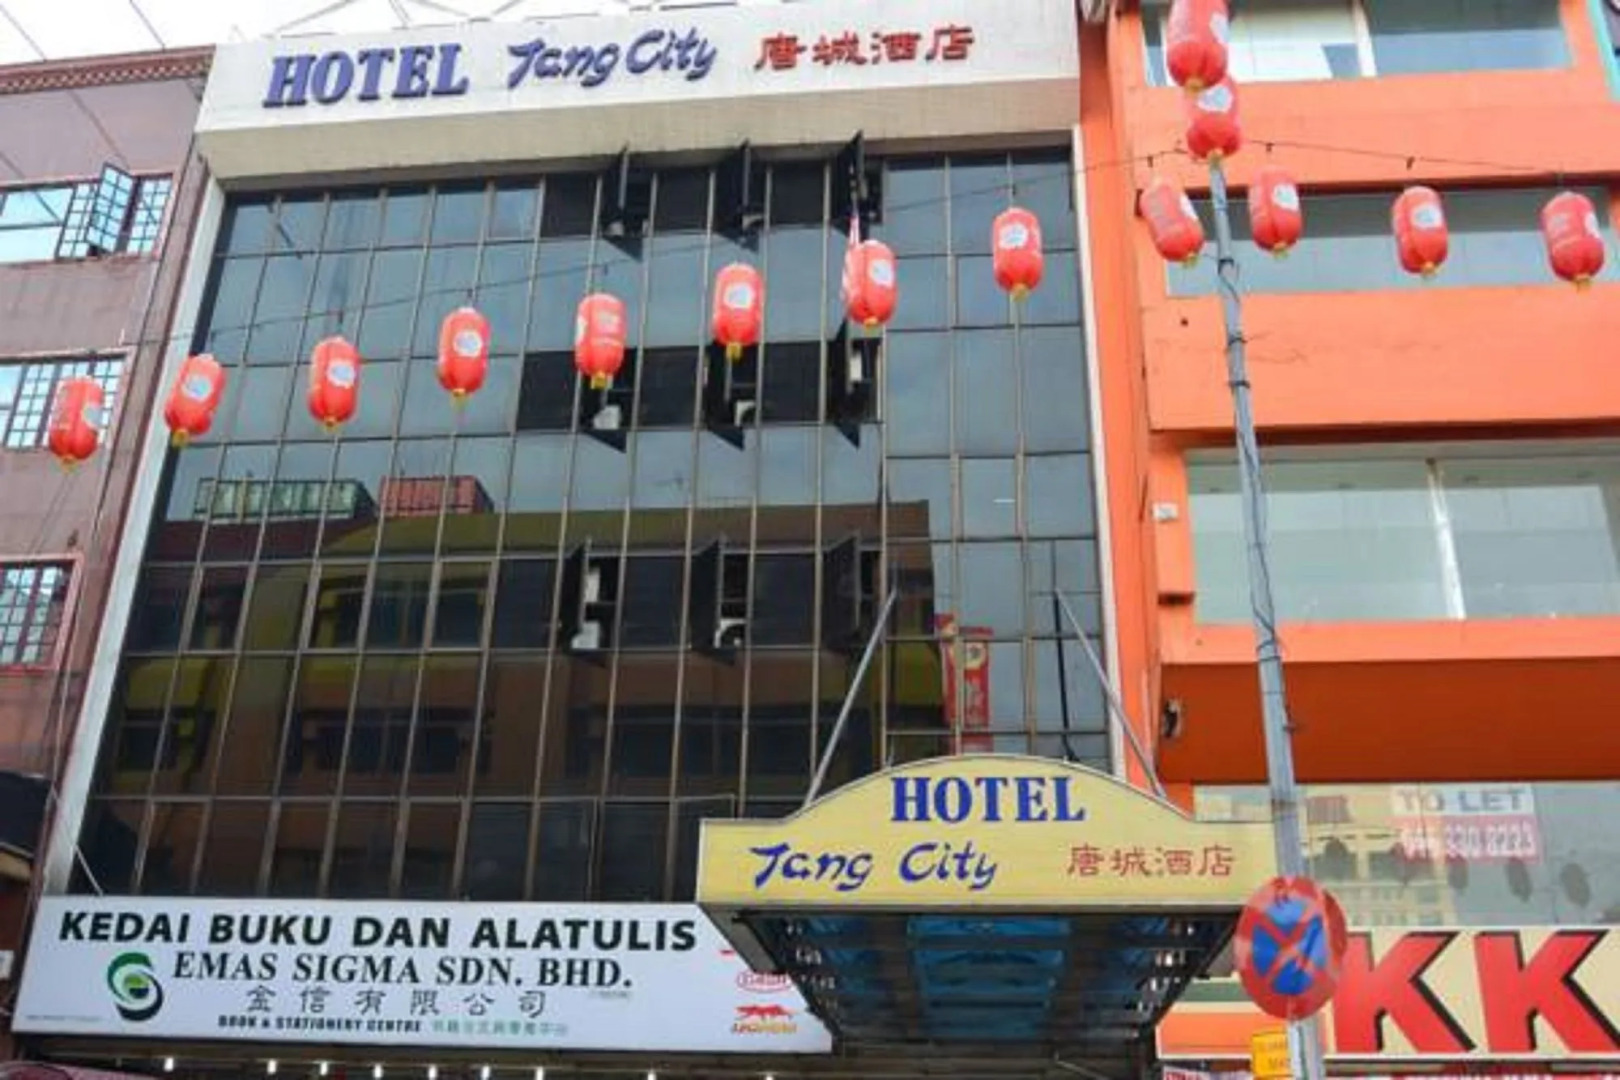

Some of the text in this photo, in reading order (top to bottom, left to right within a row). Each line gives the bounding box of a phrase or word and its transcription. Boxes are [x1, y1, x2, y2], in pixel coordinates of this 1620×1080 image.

[262, 27, 717, 108] HOTEL Tang City
[754, 24, 975, 71] 唐城酒店
[890, 776, 1086, 823] HOTEL
[1457, 786, 1526, 812] LET
[749, 841, 997, 892] Tang City
[1067, 843, 1236, 878] 唐城酒店
[59, 911, 697, 951] KEDAI BUKU DAN ALATULIS
[173, 952, 632, 987] EMAS SIGMA SDN. BHD.
